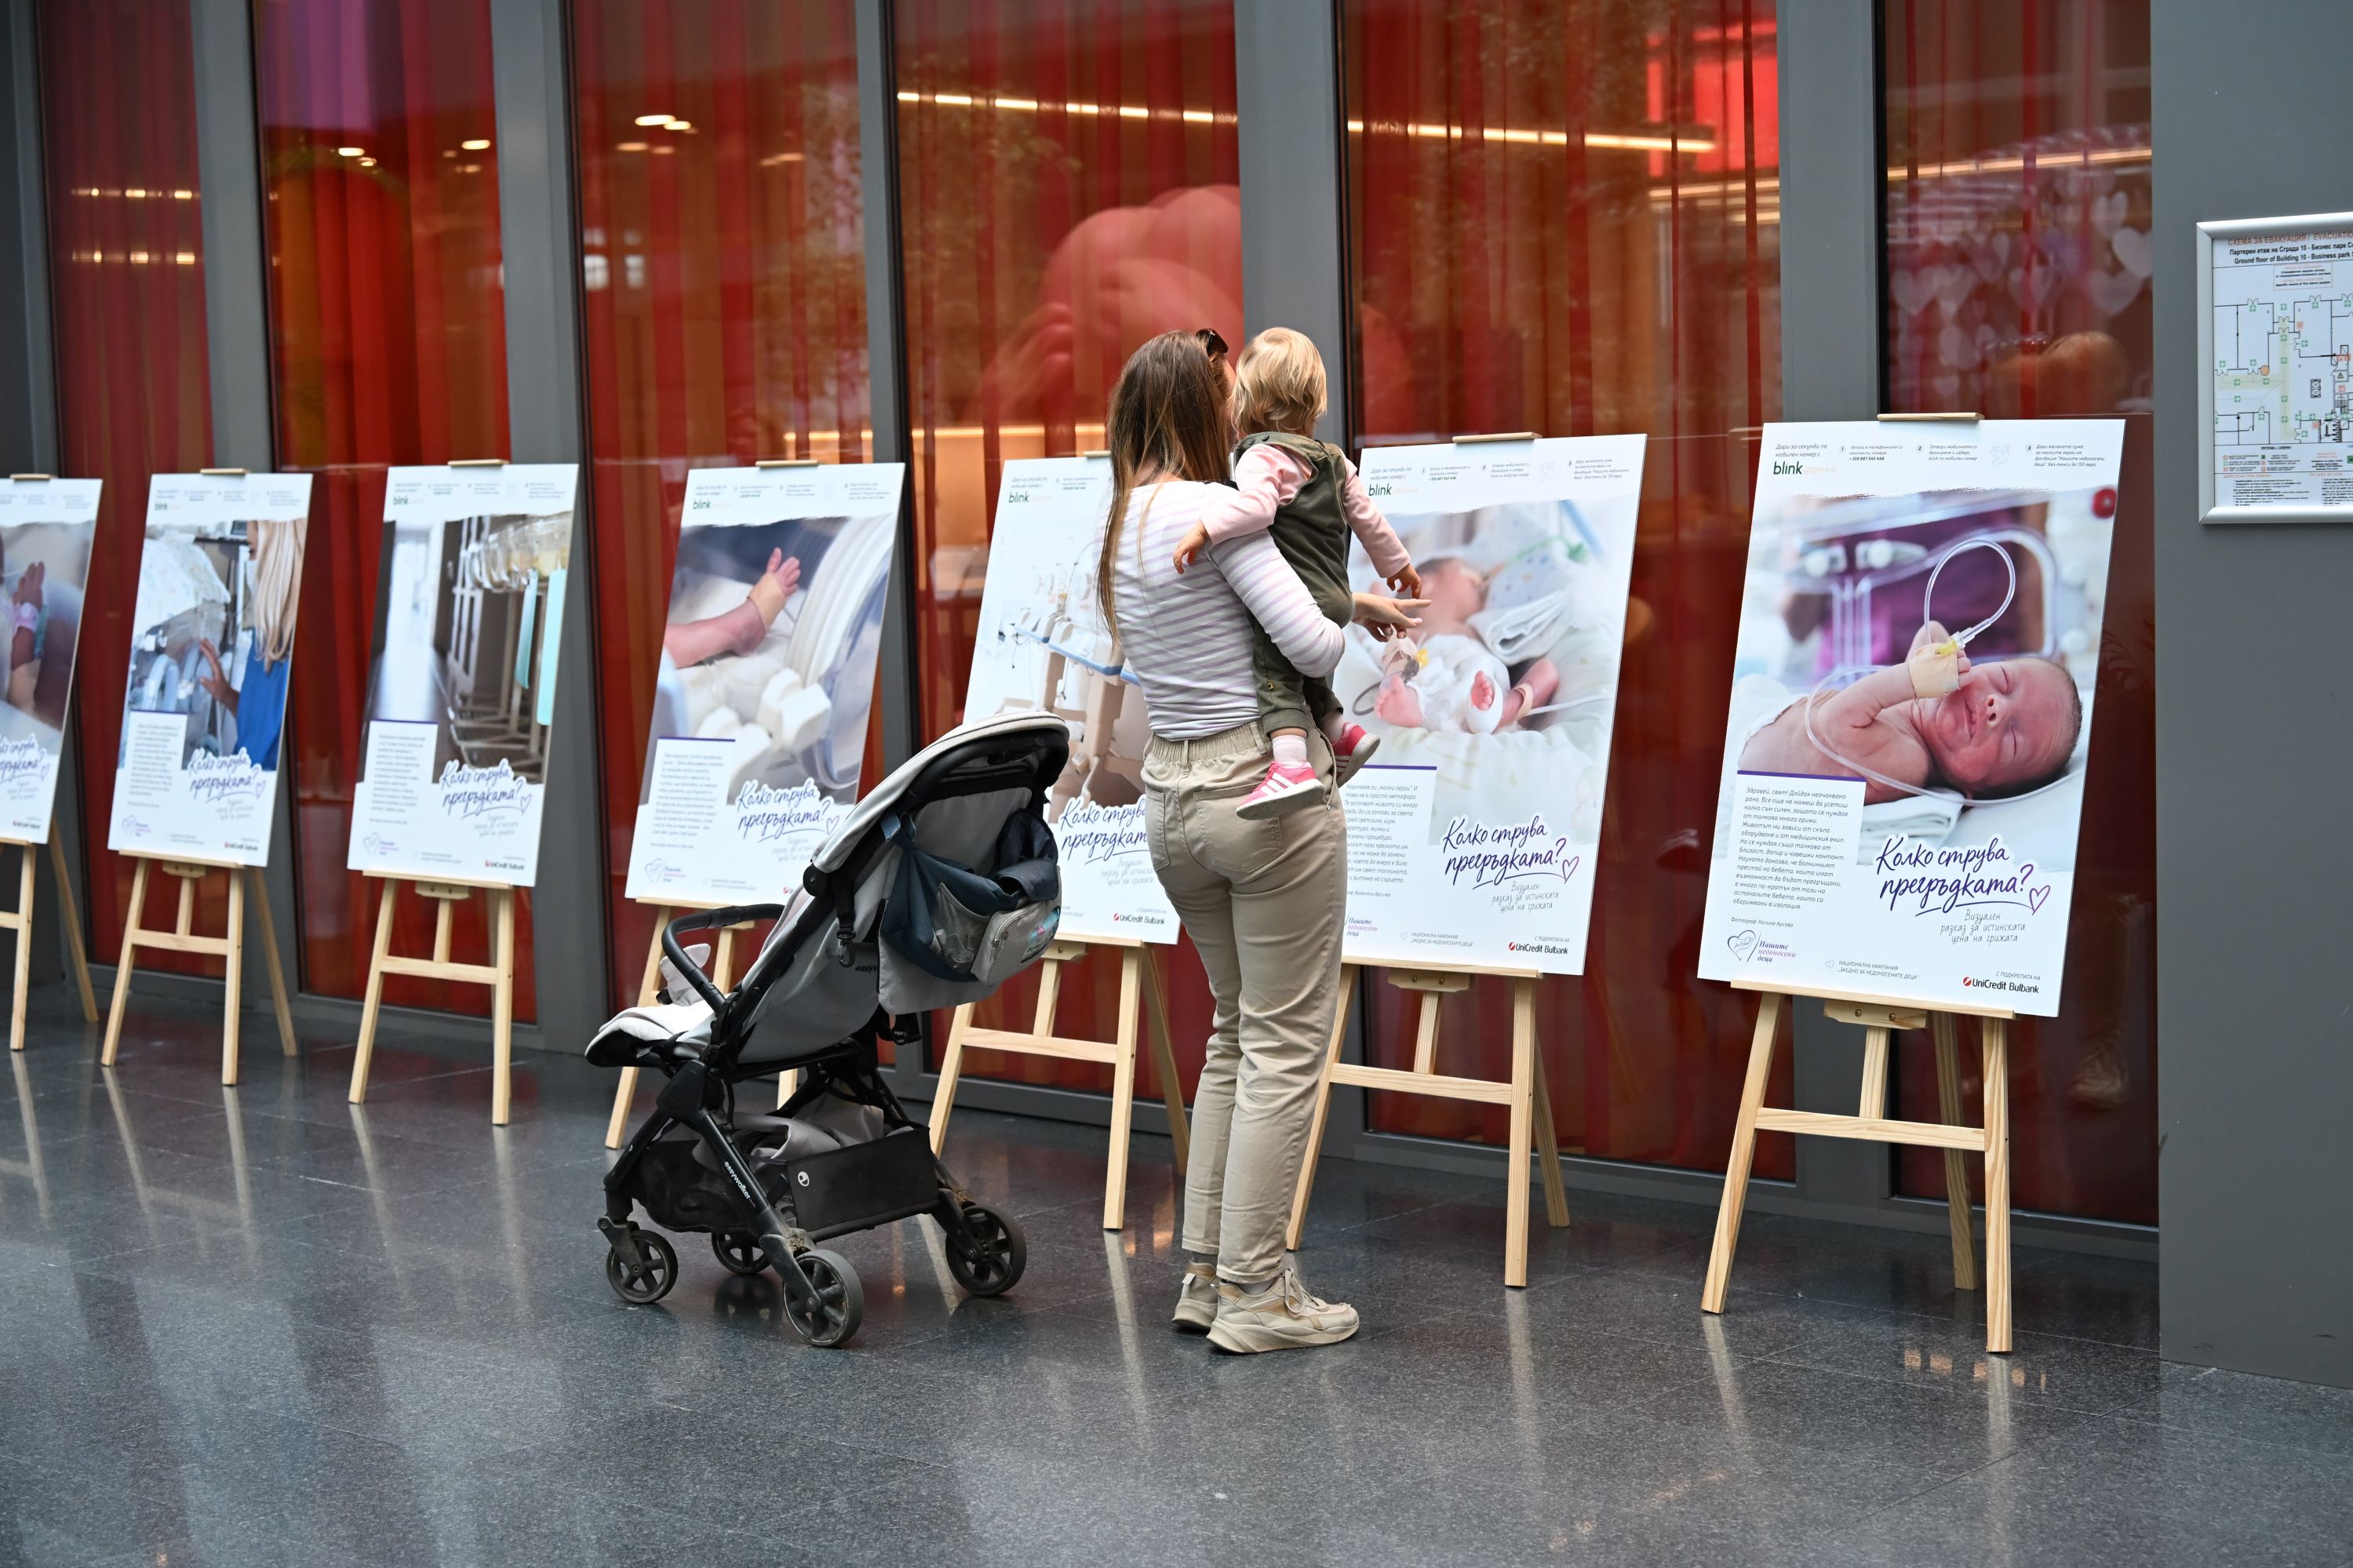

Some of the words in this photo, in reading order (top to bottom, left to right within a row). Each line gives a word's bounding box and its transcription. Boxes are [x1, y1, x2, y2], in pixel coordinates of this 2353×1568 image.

[2228, 238, 2252, 246] СХЕМА
[2265, 235, 2306, 244] ЕВАКУАЦИЯ
[1773, 461, 1803, 475] blink
[1368, 483, 1392, 496] blink
[1009, 492, 1029, 503] blink
[693, 499, 711, 510] blink
[738, 782, 772, 812] Колко
[774, 780, 816, 808] струва
[1061, 800, 1099, 831] Колко
[1443, 819, 1488, 853] Колко
[1492, 816, 1548, 848] струва
[1062, 828, 1147, 861] прегръдкат
[1444, 838, 1567, 886] прегръдката?
[1876, 836, 1933, 875] Колко
[1938, 838, 2009, 872] струва
[1511, 882, 1539, 894] Визуален
[1880, 864, 2034, 913] прегръдката?
[1120, 913, 1143, 923] UniCredit
[1144, 916, 1165, 925] Bulbank
[1965, 909, 2001, 926] Визуален
[1940, 924, 1966, 935] разказ
[1971, 924, 1979, 934] за
[1983, 923, 2025, 932] истинската
[1951, 935, 1969, 944] цена
[1987, 934, 2018, 946] грижата
[1516, 943, 1543, 953] UniCredit
[1544, 944, 1568, 955] Bulbank
[1757, 949, 1797, 958] недоносени
[1838, 960, 1871, 969] НАЦИОНАЛНА
[2000, 971, 2033, 980] ПОДКРЕПАТА
[1972, 979, 2006, 990] UniCredit
[2009, 982, 2039, 993] Bulbank
[725, 1161, 750, 1199] easywalker
